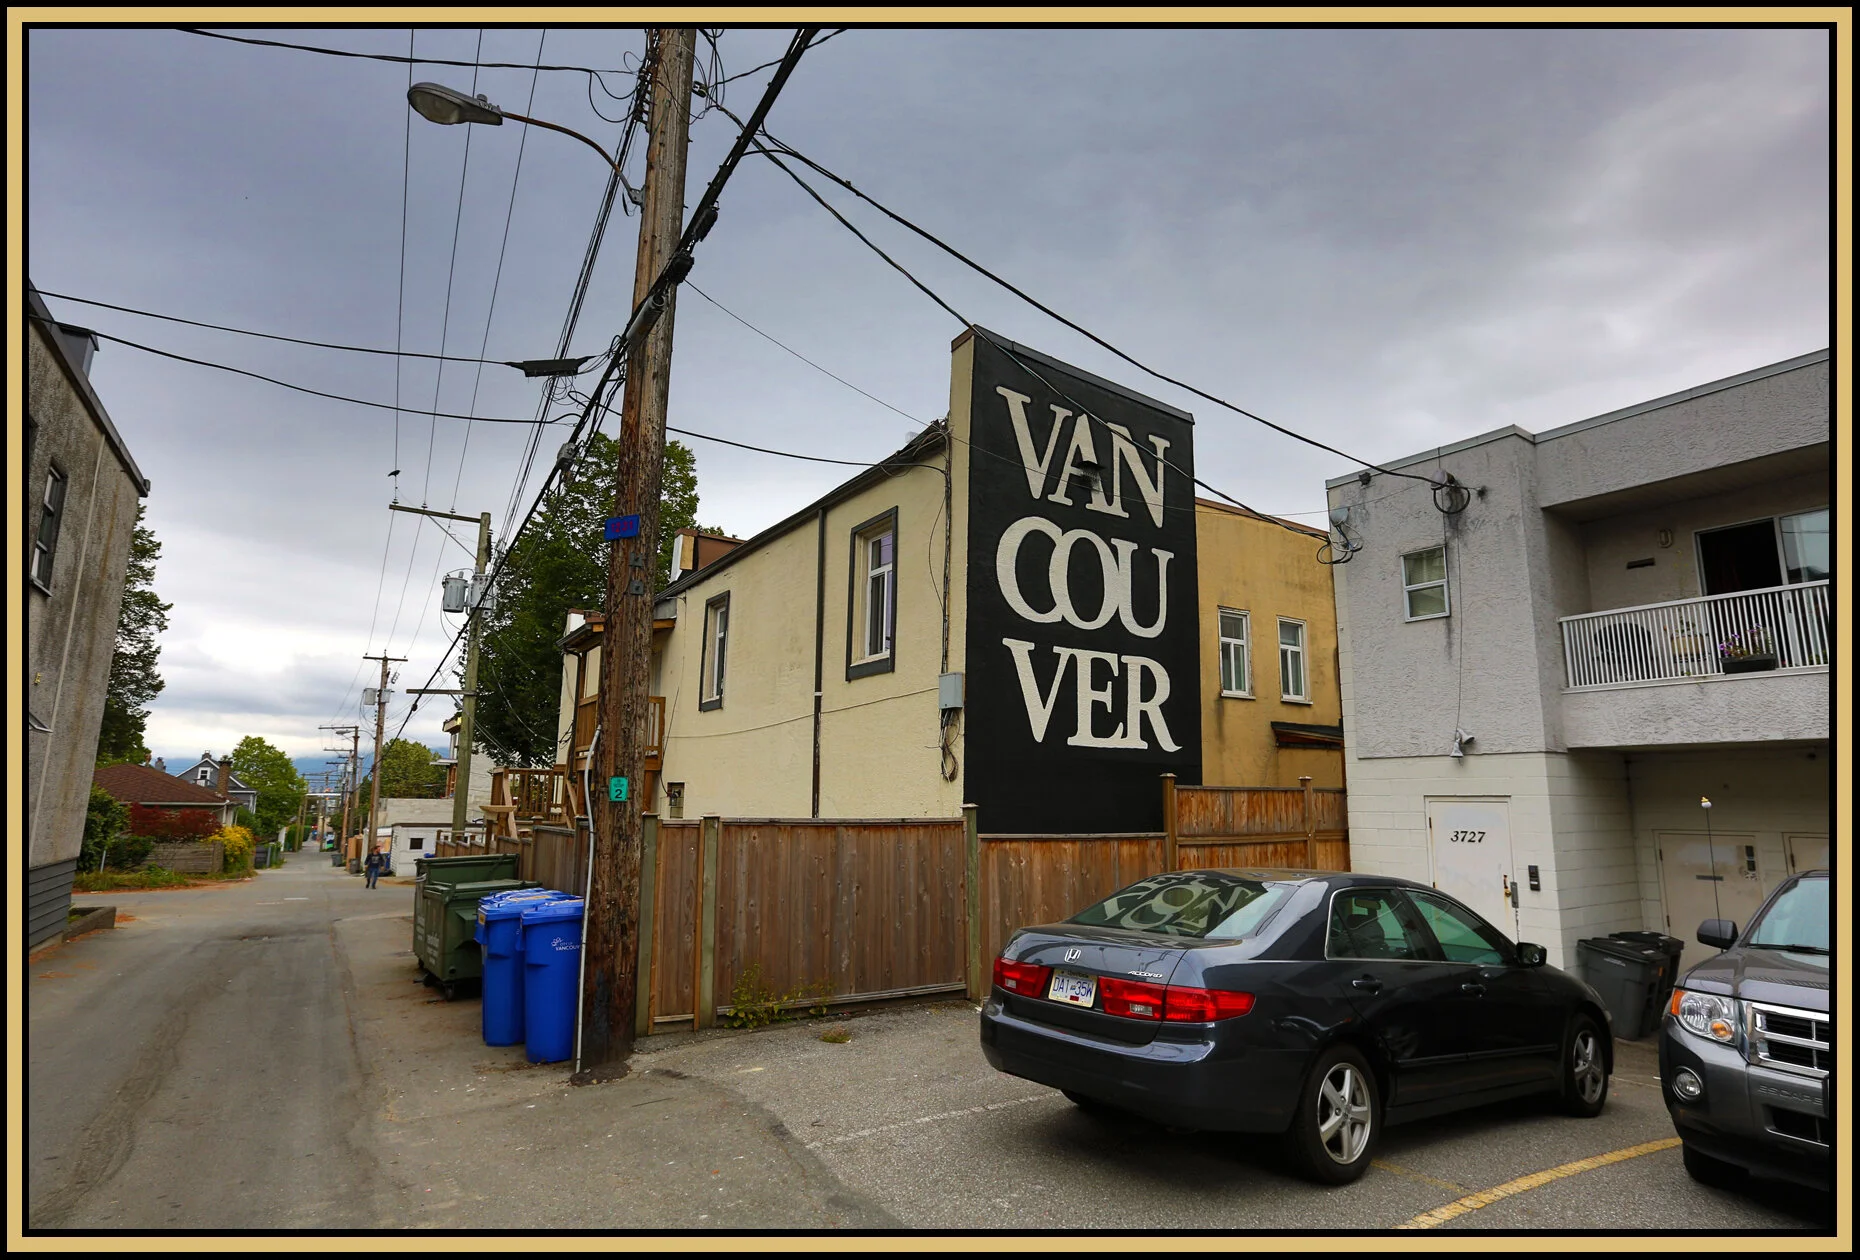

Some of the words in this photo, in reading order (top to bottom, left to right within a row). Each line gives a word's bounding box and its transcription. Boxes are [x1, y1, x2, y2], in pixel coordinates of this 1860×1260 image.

[997, 385, 1170, 528] VAN
[996, 516, 1174, 638] COU
[1002, 637, 1183, 752] VER
[614, 788, 623, 799] 2
[1450, 830, 1486, 843] 3727
[1128, 970, 1164, 979] ACCORD
